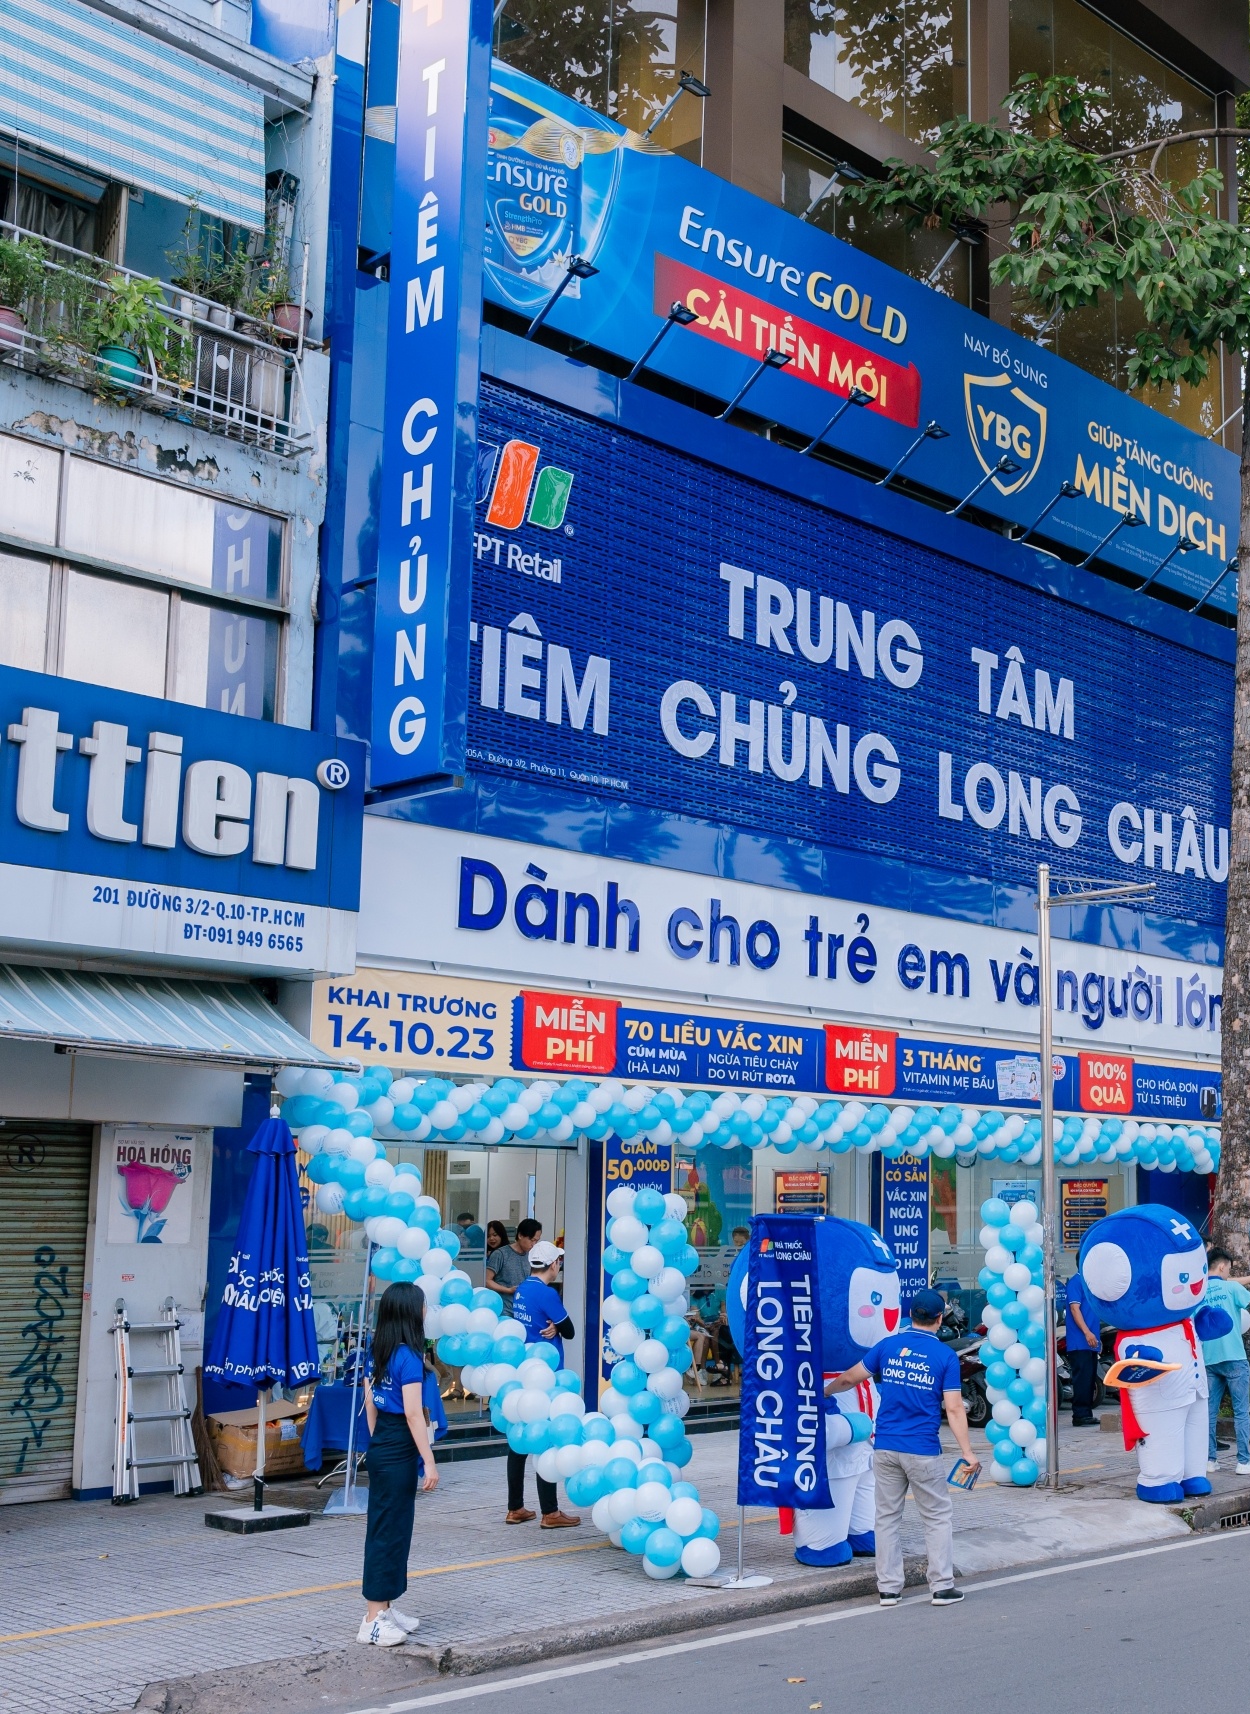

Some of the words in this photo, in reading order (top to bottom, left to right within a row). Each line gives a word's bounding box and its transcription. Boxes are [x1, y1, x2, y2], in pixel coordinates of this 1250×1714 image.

[406, 59, 446, 333] TIÊM
[519, 192, 567, 218] GOLD
[504, 210, 543, 225] StrengthPro
[511, 223, 526, 232] HMB
[679, 205, 801, 296] Ensure
[806, 271, 908, 346] GOLD
[686, 284, 744, 343] CẢI
[750, 315, 821, 385] TIẾN
[828, 350, 888, 407] MỚI
[963, 333, 990, 364] NAY
[992, 346, 1011, 374] BỔ
[1013, 355, 1049, 389] SUNG
[977, 410, 1032, 460] YBG
[1087, 421, 1124, 453] GIÚP
[1125, 437, 1161, 474] TĂNG
[1163, 459, 1214, 501] CƯỜNG
[1074, 454, 1150, 527] MIỄN
[1159, 495, 1226, 561] DỊCH
[389, 397, 438, 756] CHỦNG
[507, 543, 561, 584] Retail
[720, 562, 924, 689] TRUNG
[971, 646, 1075, 740] TÂM
[470, 612, 611, 736] IÊM
[660, 680, 902, 804] CHỦNG
[939, 751, 1083, 849] LONG
[1108, 805, 1229, 883] CHÂU
[488, 753, 513, 767] Đường
[530, 763, 556, 776] Phường
[570, 771, 590, 782] Quận
[0, 706, 320, 870] ttien
[93, 886, 120, 906] 201
[127, 884, 182, 913] ĐƯỜNG
[185, 897, 305, 928] 3/2-Q.10-TP.HCM
[237, 929, 263, 948] 949
[268, 932, 304, 952] 6565
[457, 855, 640, 953] Dành
[667, 898, 781, 970] cho
[804, 912, 878, 984] trẻ
[898, 943, 970, 998] em
[989, 946, 1040, 1006] và
[1056, 965, 1163, 1030] người
[328, 985, 390, 1009] KHAI
[397, 994, 497, 1020] TRƯƠNG
[535, 999, 606, 1034] MIỄN
[328, 1014, 494, 1060] 14.10.23
[546, 1035, 596, 1063] PHÍ
[624, 1020, 654, 1041] 70
[660, 1019, 711, 1047] LIỀU
[717, 1023, 762, 1051] VẮC
[767, 1035, 803, 1056] XIN
[835, 1032, 888, 1063] MIỄN
[627, 1045, 656, 1059] CÚM
[658, 1047, 687, 1061] MÙA
[708, 1053, 741, 1067] NGỪA
[743, 1054, 768, 1069] TIÊU
[769, 1057, 799, 1071] CHẢY
[902, 1049, 914, 1067] 3
[918, 1048, 982, 1073] THÁNG
[627, 1059, 650, 1074] (HÀ
[652, 1063, 681, 1077] LAN)
[708, 1068, 726, 1080] DO
[728, 1070, 740, 1081] VI
[742, 1069, 763, 1082] RÚT
[765, 1073, 796, 1085] ROTA
[844, 1066, 880, 1089] PHÍ
[1087, 1060, 1127, 1081] 100%
[903, 1071, 951, 1089] VITAMIN
[952, 1074, 970, 1092] MẸ
[972, 1073, 995, 1090] BẦU
[1089, 1081, 1126, 1105] QUÀ
[1136, 1078, 1156, 1090] CHO
[1158, 1078, 1177, 1092] HÓA
[1179, 1080, 1199, 1094] ĐƠN
[1136, 1091, 1147, 1103] TỪ
[1149, 1094, 1161, 1105] 1.5
[1162, 1095, 1187, 1108] TRIỆU
[117, 1146, 146, 1163] HOA
[637, 1180, 662, 1191] NHÓM
[885, 1167, 902, 1182] CÓ
[904, 1166, 927, 1183] SẴN
[886, 1187, 908, 1202] VẮC
[909, 1190, 927, 1202] XIN
[890, 1206, 922, 1219] NGỪA
[893, 1225, 919, 1237] UNG
[776, 1251, 792, 1261] LONG
[793, 1250, 812, 1261] CHÂU
[894, 1240, 919, 1254] THƯ
[904, 1258, 926, 1270] HPV
[910, 1277, 926, 1287] CHO
[791, 1274, 813, 1352] TIÊM
[755, 1281, 783, 1381] LONG
[883, 1367, 906, 1379] LONG
[908, 1372, 935, 1385] CHÂU
[888, 1357, 902, 1367] NHÀ
[905, 1360, 930, 1372] THUỐC
[794, 1361, 818, 1492] CHỦNG
[754, 1393, 784, 1489] CHÂU
